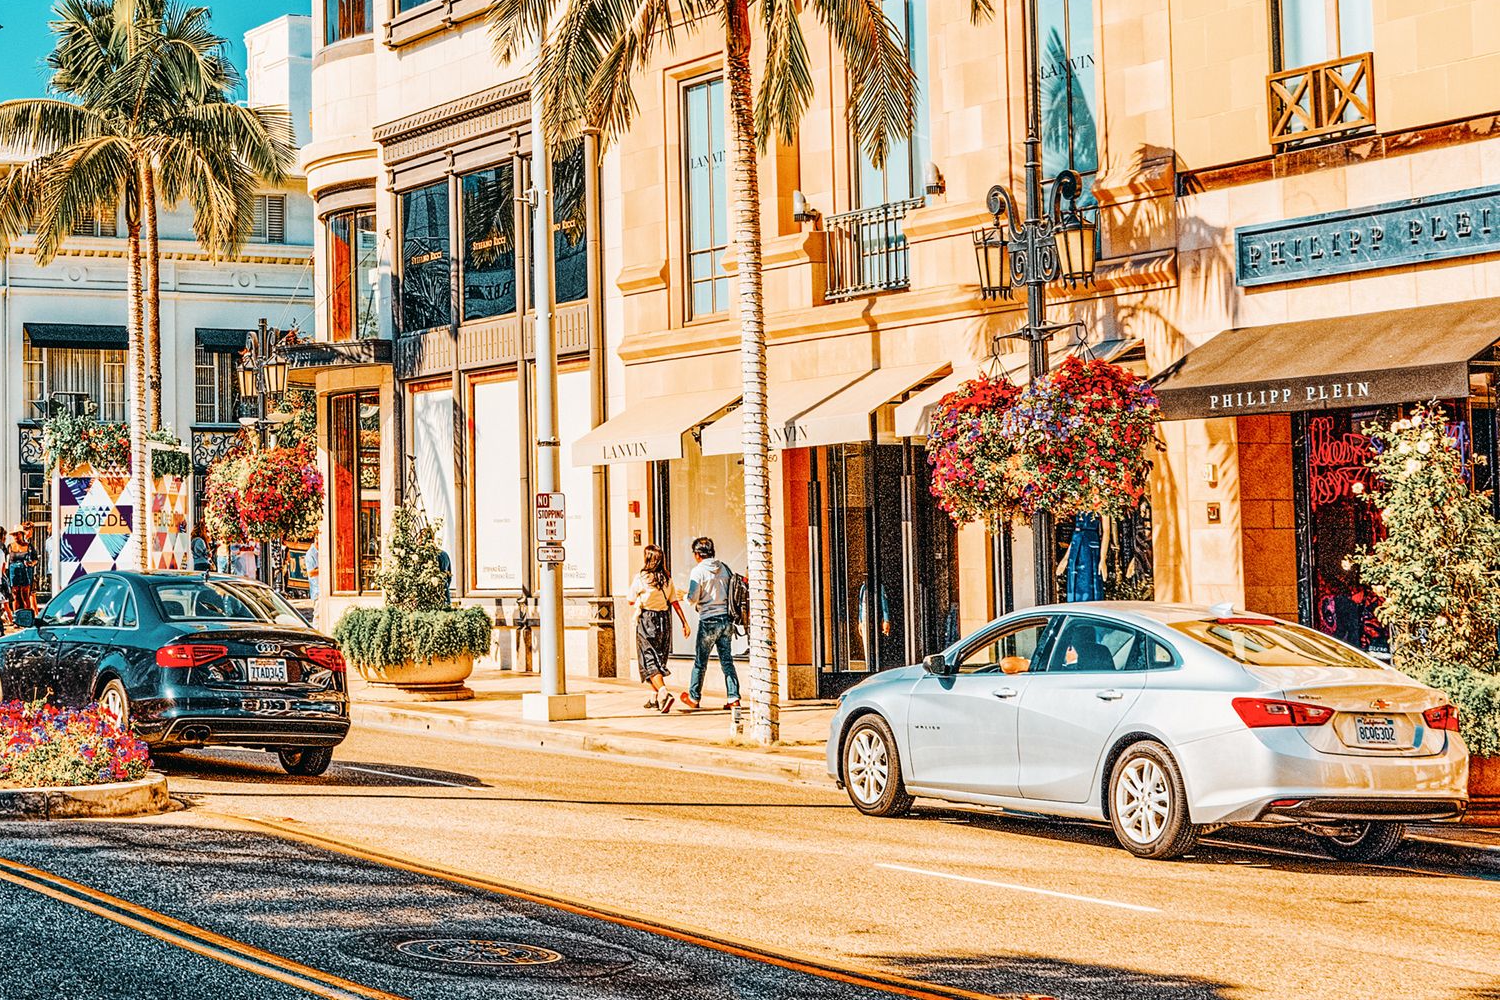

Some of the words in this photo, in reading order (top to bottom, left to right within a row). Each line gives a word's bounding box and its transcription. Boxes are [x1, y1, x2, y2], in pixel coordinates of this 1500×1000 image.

[1040, 53, 1095, 80] LANVIN
[1249, 224, 1384, 269] PHILIPP
[1407, 206, 1492, 245] PLEI
[1209, 387, 1292, 410] PHILIPP
[1306, 381, 1371, 402] PLEIN
[768, 425, 808, 444] NVIN
[603, 442, 648, 460] LANVIN
[537, 495, 549, 507] NO
[538, 509, 564, 520] STOPPING
[545, 520, 557, 528] ANY
[545, 528, 557, 536] TIME
